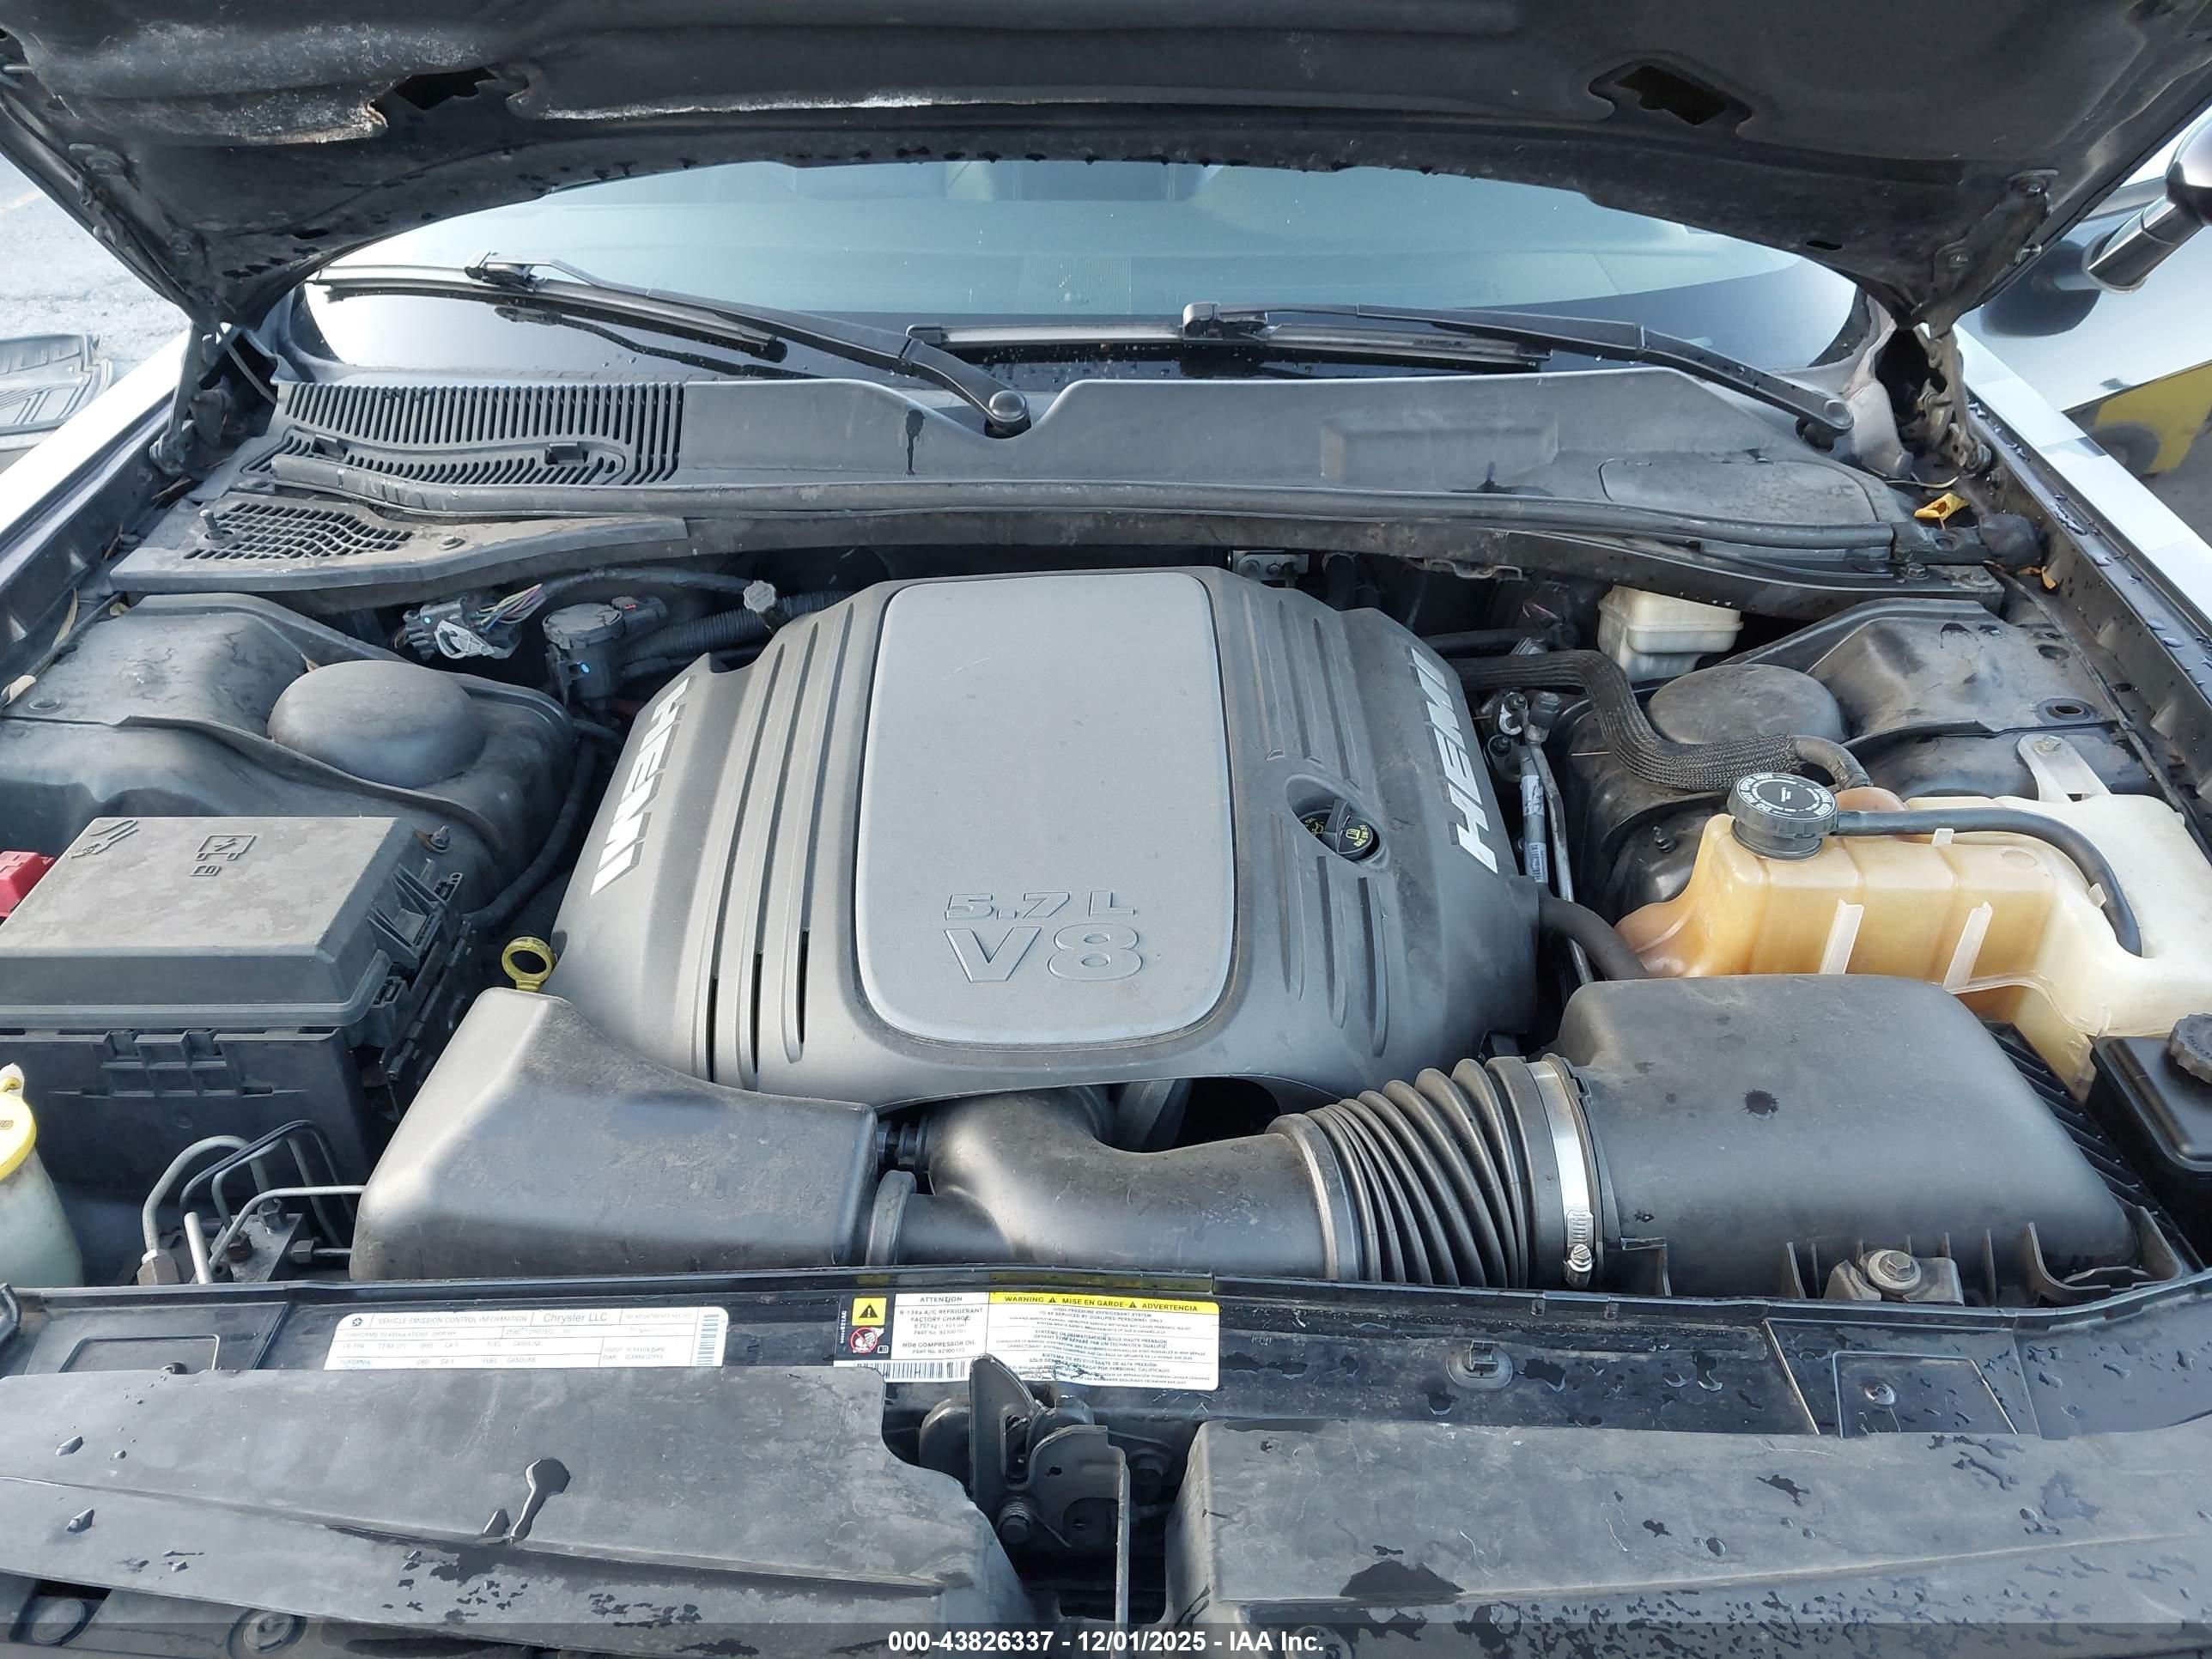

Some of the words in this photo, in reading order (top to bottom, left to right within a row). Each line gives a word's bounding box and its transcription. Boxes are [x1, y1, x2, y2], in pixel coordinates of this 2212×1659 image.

[590, 677, 690, 896] HEMI
[1411, 647, 1498, 873] HEMI
[945, 923, 1143, 983] V8
[543, 1313, 586, 1324] Chrysler
[588, 1312, 608, 1322] LLC
[1141, 1303, 1198, 1311] ADVERTENCIA
